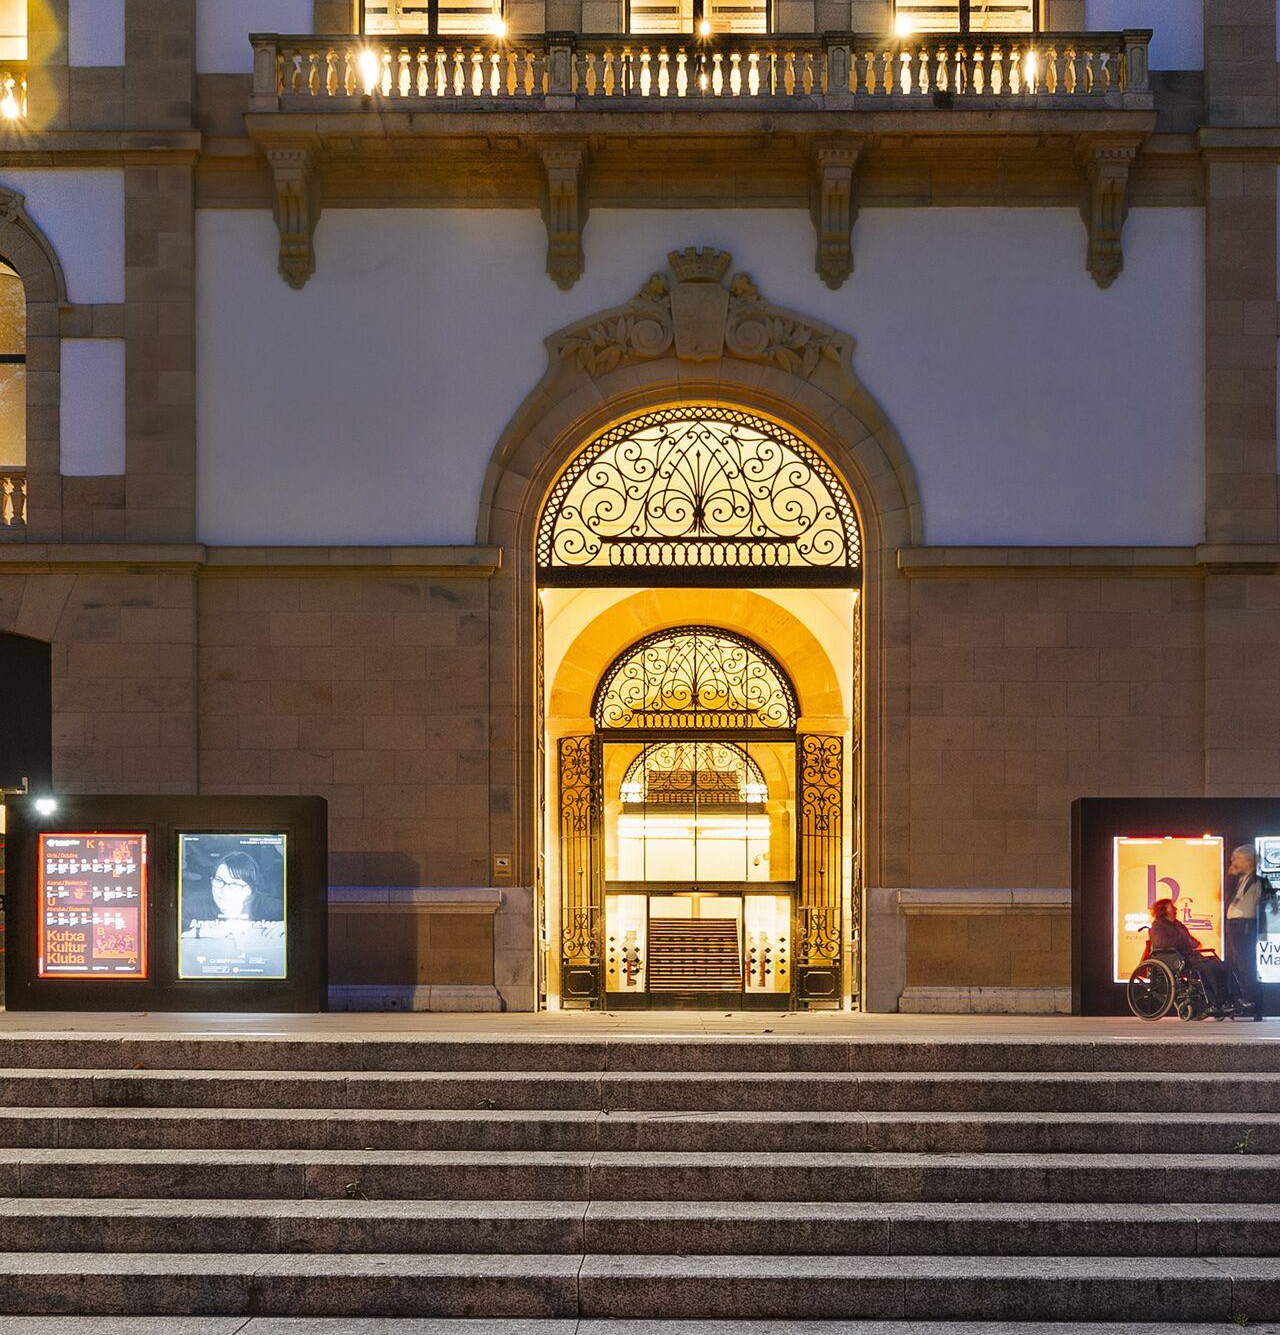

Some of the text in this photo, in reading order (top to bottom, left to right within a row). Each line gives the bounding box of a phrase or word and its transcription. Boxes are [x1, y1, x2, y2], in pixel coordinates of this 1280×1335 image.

[86, 840, 95, 848] K
[48, 897, 56, 905] U
[46, 930, 85, 941] Kutxa
[46, 942, 87, 952] Kultur
[46, 953, 85, 964] Kluba
